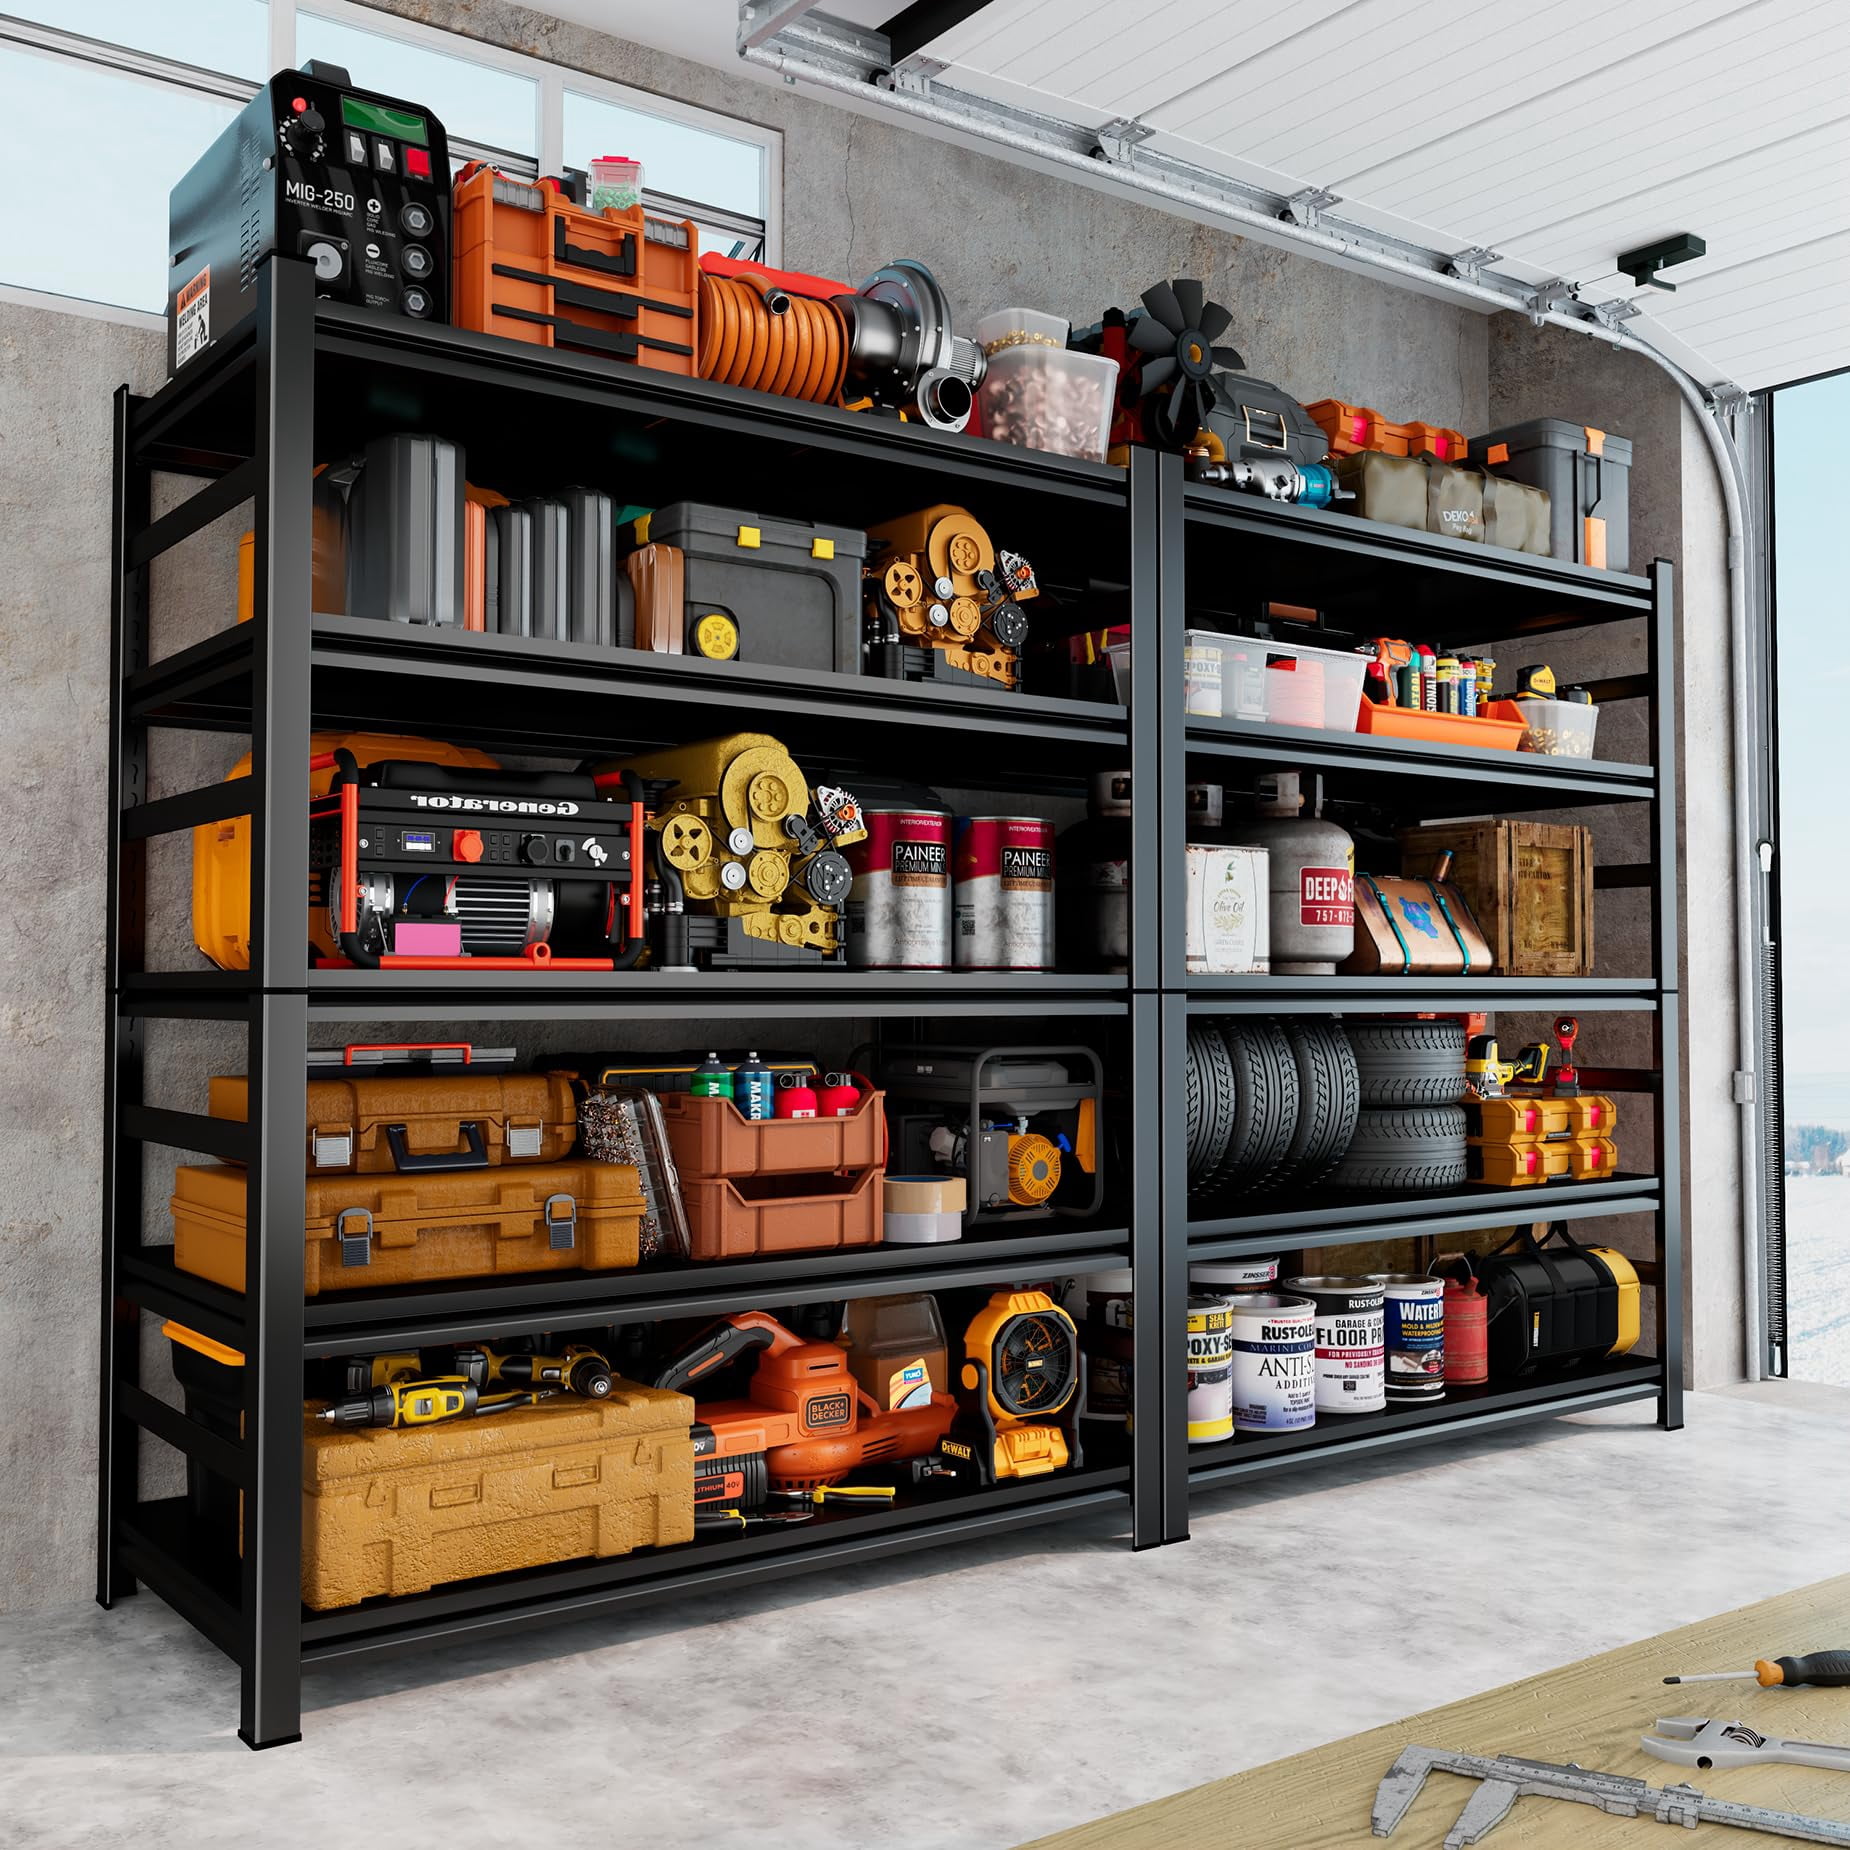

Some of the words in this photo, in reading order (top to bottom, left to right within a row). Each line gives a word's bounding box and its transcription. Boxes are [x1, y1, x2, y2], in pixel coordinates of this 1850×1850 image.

[286, 179, 355, 211] MIG-250
[895, 845, 946, 862] PAINEER
[895, 860, 929, 873] PREMIUM
[1305, 876, 1338, 901] DEEP
[1213, 900, 1231, 913] Olive
[1232, 900, 1245, 913] Oil
[709, 1082, 720, 1097] M
[1242, 1271, 1270, 1279] ZINSSER
[1336, 1319, 1366, 1329] GARAGE
[1367, 1318, 1372, 1328] &
[1261, 1323, 1315, 1341] RUST-OLE
[1316, 1328, 1367, 1346] FLOOR
[1249, 1344, 1294, 1352] MARINE
[1257, 1356, 1315, 1378] ANTI-S
[811, 1409, 846, 1421] DECKER
[942, 1440, 971, 1459] DEWALT
